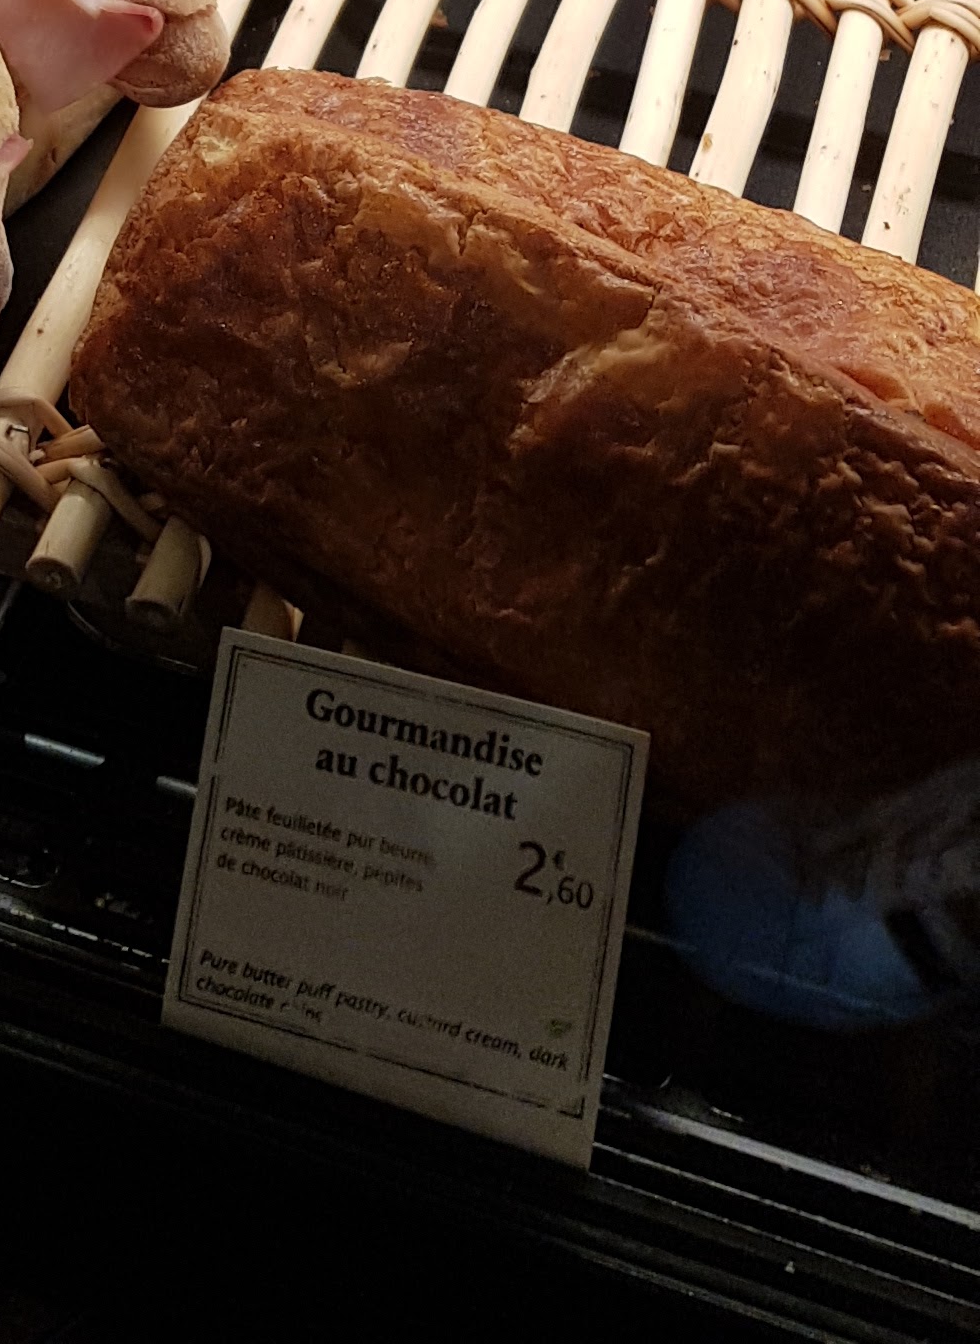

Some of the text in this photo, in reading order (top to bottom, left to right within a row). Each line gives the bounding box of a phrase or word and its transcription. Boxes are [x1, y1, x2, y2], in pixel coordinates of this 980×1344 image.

[306, 688, 544, 776] Gourmandise
[315, 748, 518, 820] au chocolat
[220, 826, 270, 852] crème
[226, 796, 261, 821] Pâte
[266, 806, 341, 842] feuilletée
[347, 831, 376, 849] pur
[217, 852, 237, 872] de
[242, 858, 310, 892] chocolat
[196, 975, 276, 1009] chocolate
[200, 950, 238, 975] Pure
[242, 962, 292, 989] butter
[295, 980, 336, 999] puff
[465, 1027, 522, 1059] cream,
[528, 1046, 569, 1071] dark
